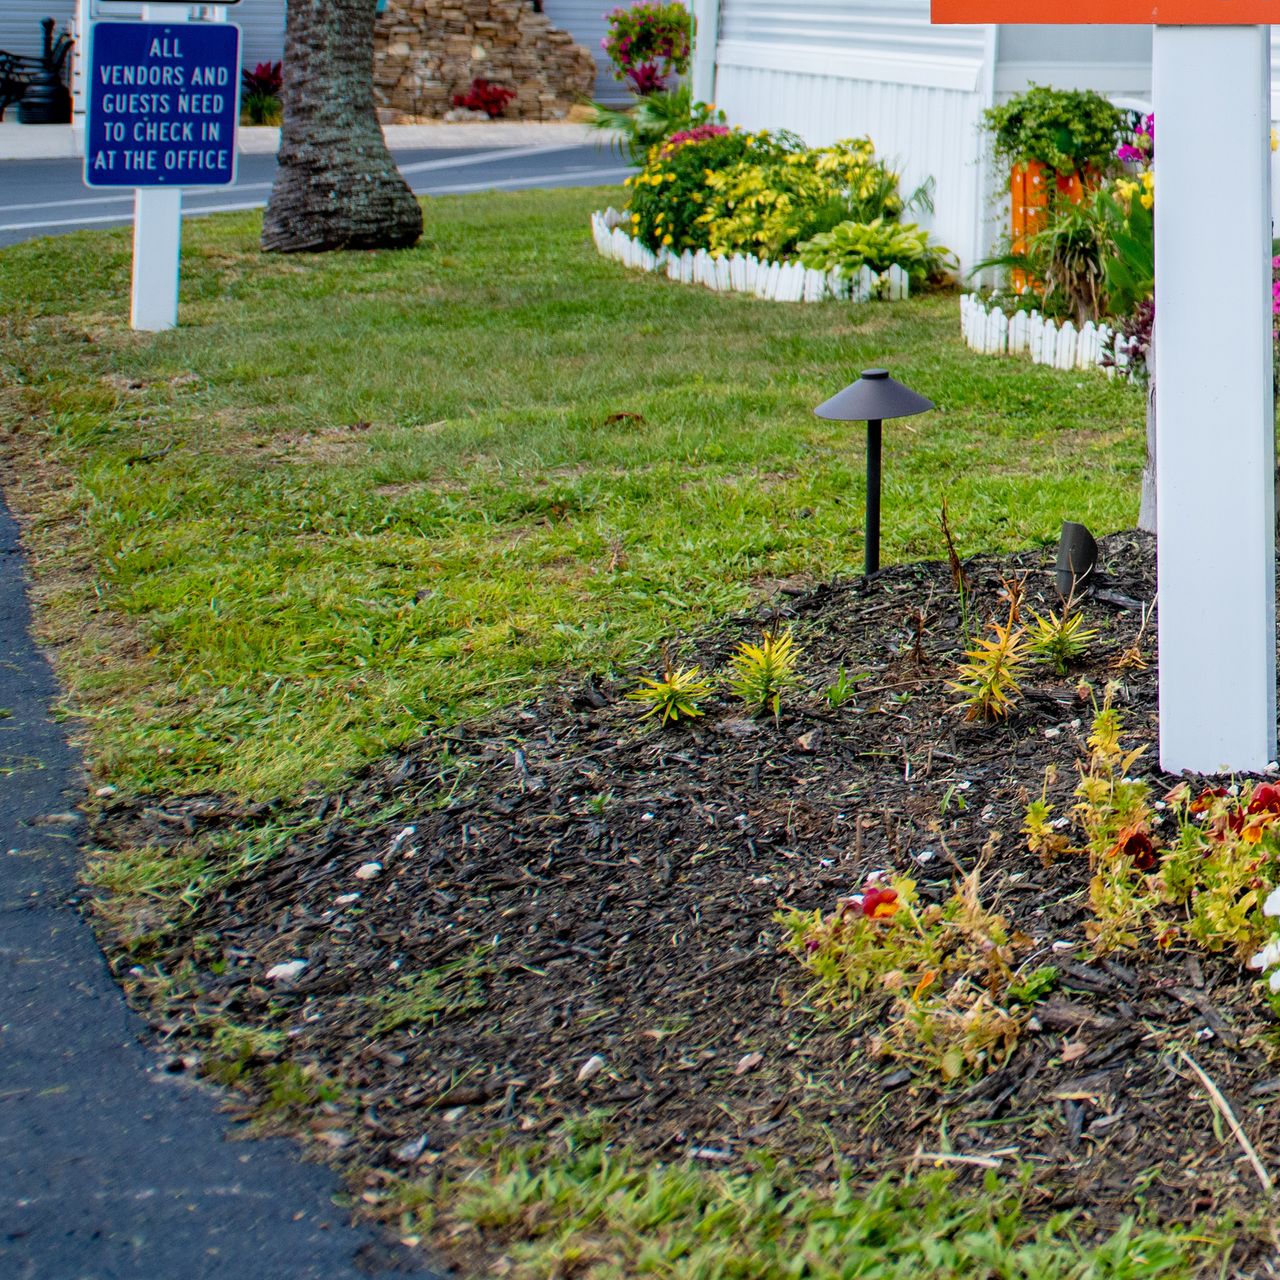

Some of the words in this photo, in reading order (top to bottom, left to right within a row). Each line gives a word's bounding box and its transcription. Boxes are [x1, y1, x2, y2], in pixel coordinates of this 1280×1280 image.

[149, 37, 184, 58] ALL
[100, 65, 185, 86] VENDORS
[191, 66, 229, 86] AND
[102, 93, 170, 114] GUESTS
[178, 93, 224, 114] NEED
[103, 121, 126, 142] TO
[133, 121, 194, 142] CHECK
[200, 121, 220, 142] IN
[94, 149, 117, 170] AT
[123, 149, 158, 170] THE
[164, 149, 228, 170] OFFICE
